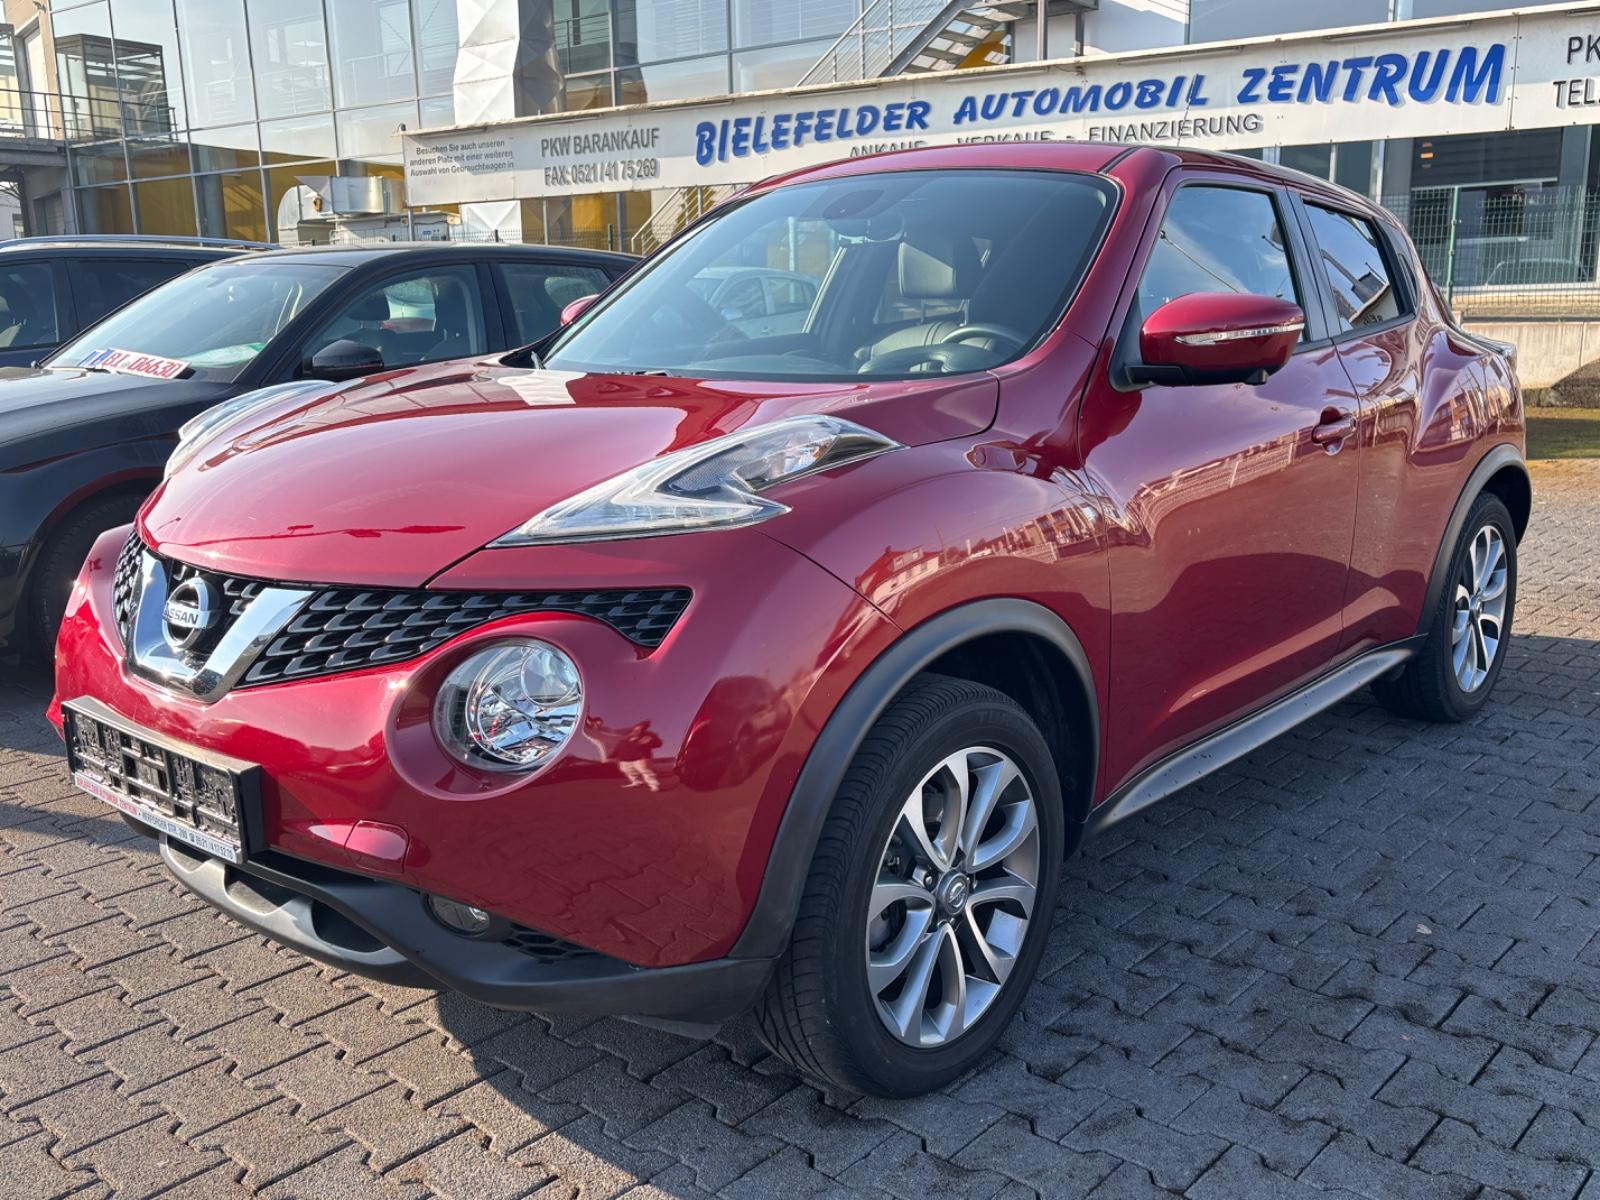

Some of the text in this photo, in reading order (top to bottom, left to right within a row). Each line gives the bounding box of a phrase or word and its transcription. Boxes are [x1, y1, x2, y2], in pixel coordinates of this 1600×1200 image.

[695, 43, 1506, 167] BIELEFELDER AUTOMOBIL ZENTRUM
[540, 128, 660, 158] PKW BARANKAUF
[1089, 113, 1262, 143] FINANZIERUNG
[416, 145, 448, 155] Besuchen
[449, 143, 460, 152] Sie
[460, 142, 477, 151] auch
[544, 165, 571, 187] FAX:
